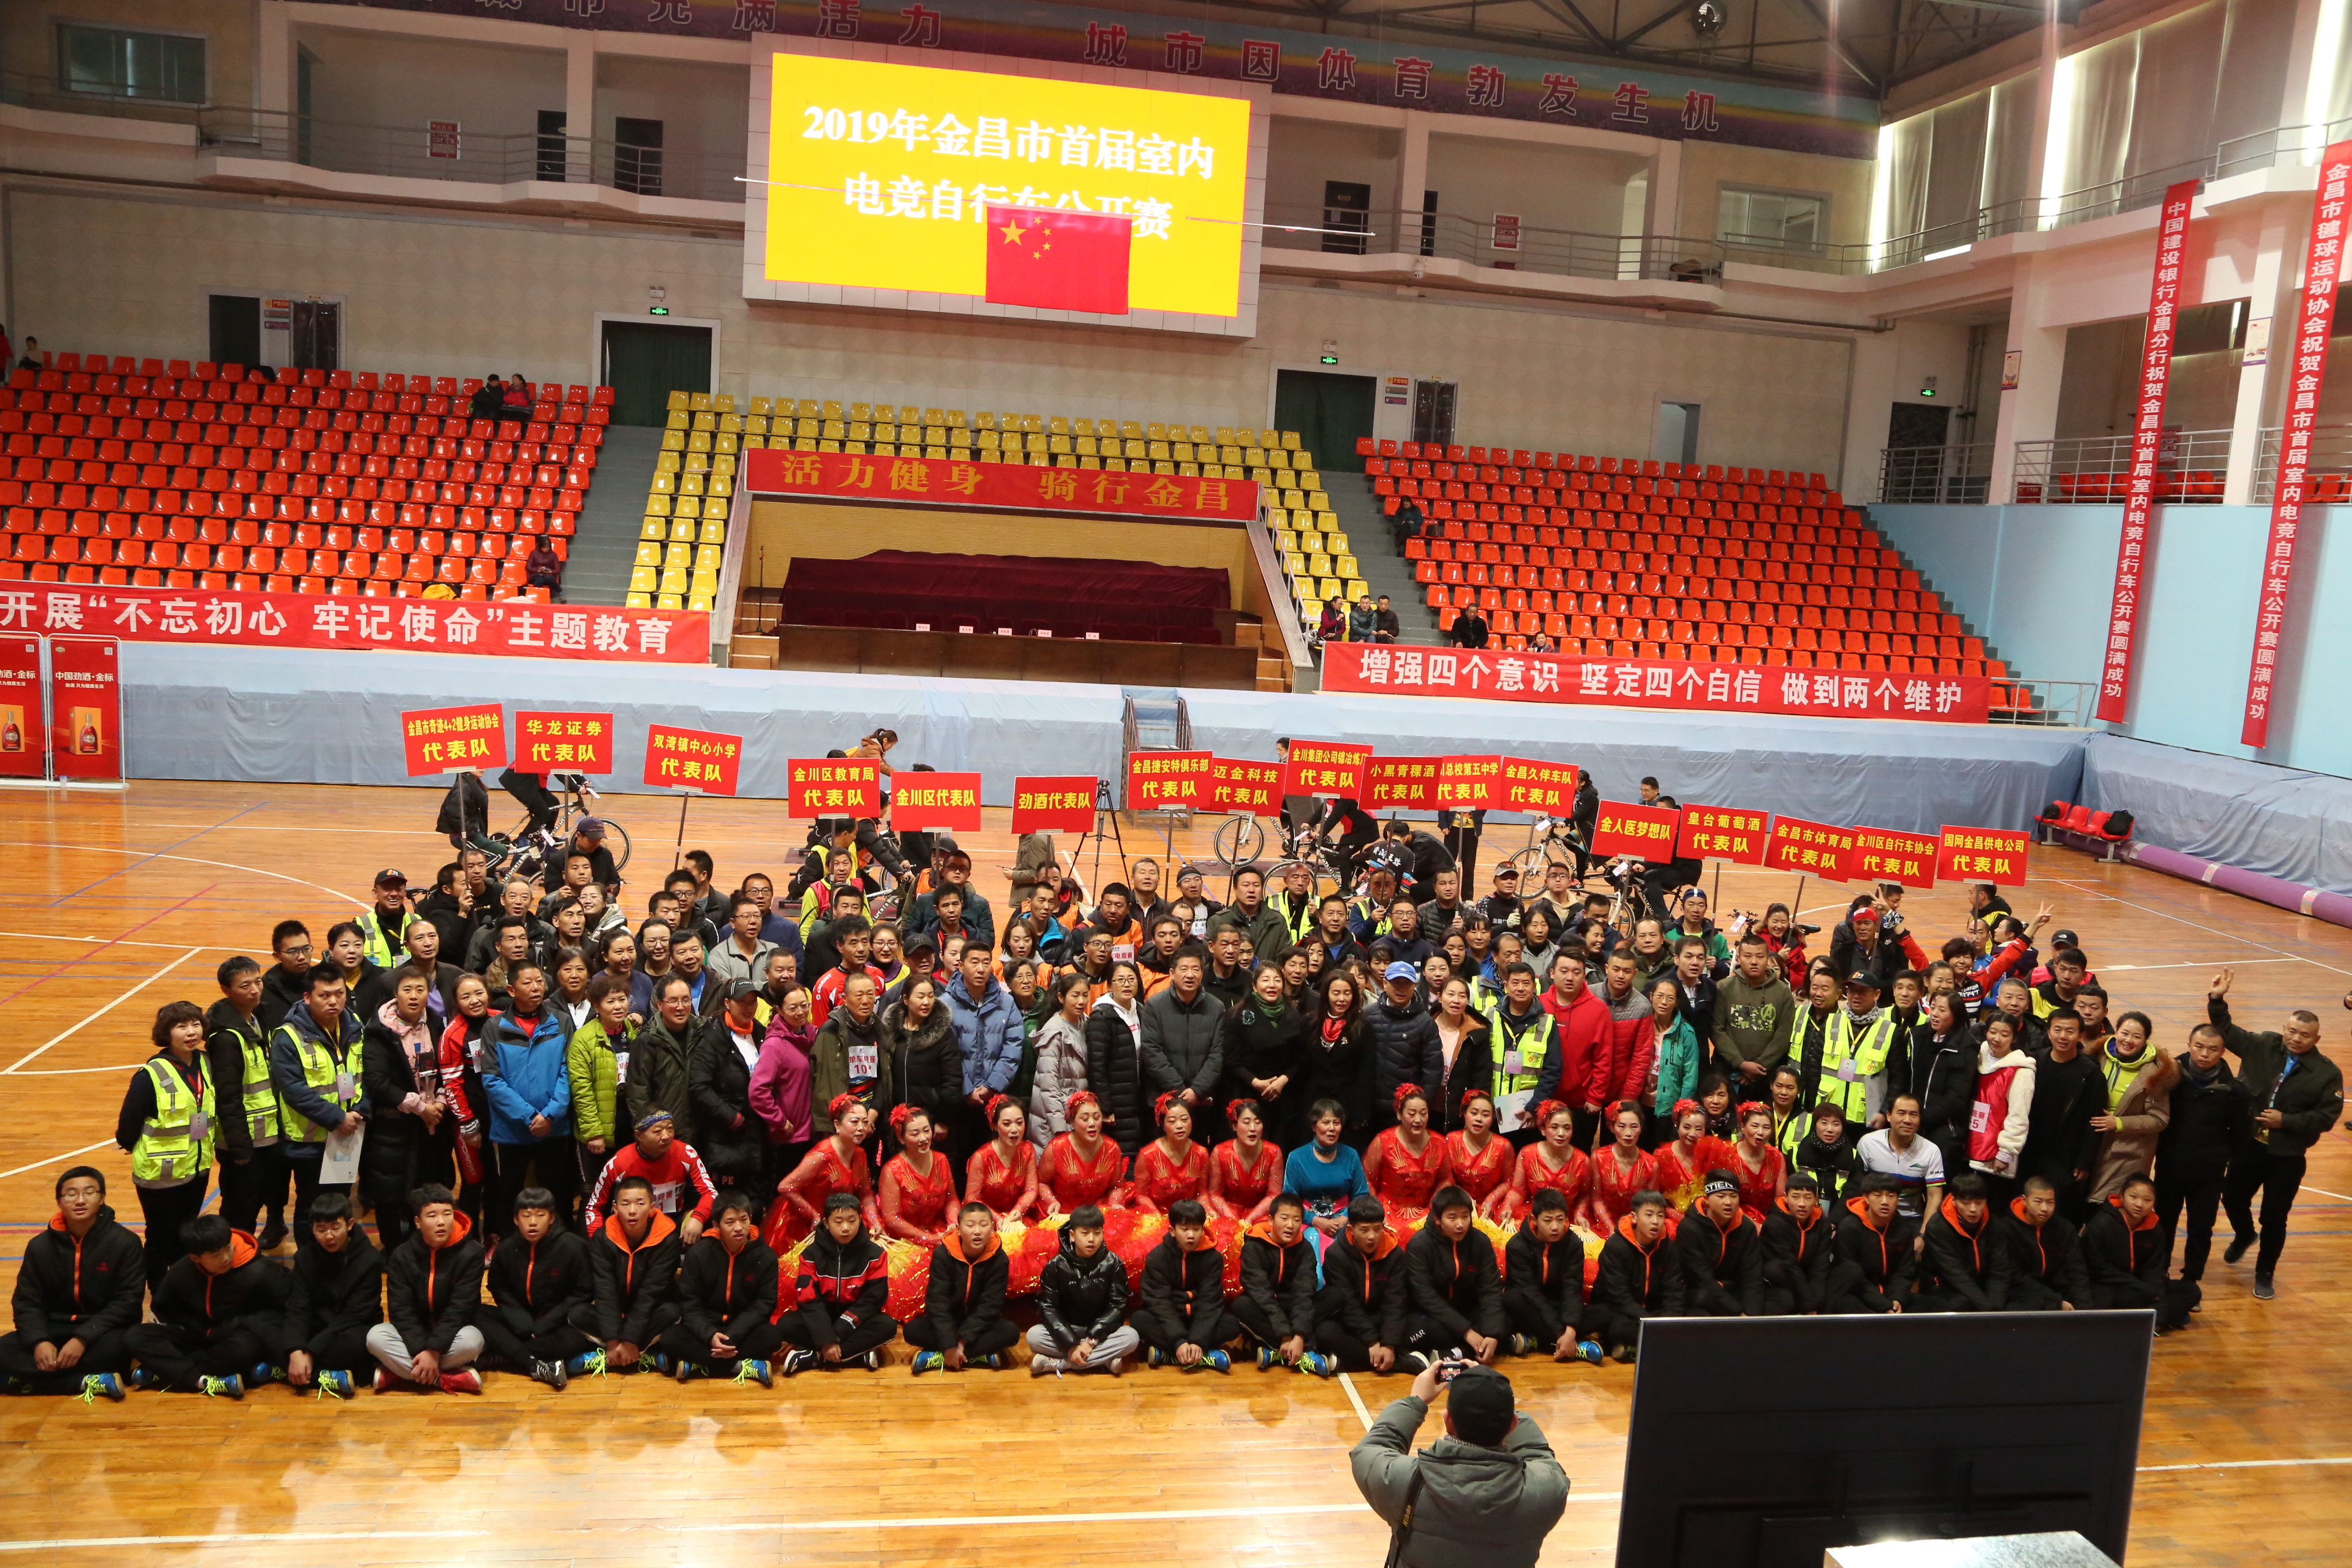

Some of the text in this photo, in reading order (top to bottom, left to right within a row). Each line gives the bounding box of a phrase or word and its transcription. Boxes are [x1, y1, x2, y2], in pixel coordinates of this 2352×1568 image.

[1084, 21, 1718, 132] 城市因体育勃发生机
[802, 107, 1215, 180] 2019年金昌市首届室内
[2105, 202, 2186, 698] 中国建设银行金昌分行祝贺金昌市首届室内电竞自行车公开赛圆满成功
[782, 454, 1229, 511] 活力健身 骑行金昌
[0, 590, 673, 655] 开展“不忘初心 牢记使命”主题教育
[55, 671, 115, 683] 中国劲酒·金标
[1358, 649, 1963, 715] 增强四个意识 坚定四个自信 做到两个维护
[408, 711, 499, 737] 金昌市奇迹4+2健身运动协会
[526, 719, 602, 736] 华龙证券
[423, 738, 490, 763] 代表队
[531, 743, 596, 762] 代表队
[653, 734, 736, 759] 双湾镇中心小学
[1292, 747, 1368, 766] 金川集团公司镍冶炼厂
[660, 757, 722, 783] 代表队
[794, 767, 874, 782] 金川区教育局
[1133, 758, 1209, 774] 金昌捷安特俱乐部
[1213, 764, 1278, 783] 迈金科技
[1370, 764, 1435, 777] 小黑青稞酒
[1505, 764, 1572, 785] 金昌久伴车队
[1300, 769, 1355, 788] 代表队
[803, 789, 865, 807] 代表队
[896, 788, 975, 807] 金川区代表队
[1142, 780, 1197, 799] 代表队
[1215, 786, 1268, 805] 代表队
[1373, 783, 1425, 801] 代表队
[1438, 783, 1488, 800] 代表队
[1510, 786, 1561, 807] 代表队
[1018, 792, 1091, 810] 劲酒代表队
[1600, 816, 1670, 842] 金人医梦想队
[1687, 812, 1760, 832] 皇台葡萄酒
[1693, 833, 1749, 854] 代表队
[1777, 824, 1852, 851] 金昌市体育局
[1856, 834, 1935, 857] 金川区自行车协会
[1944, 835, 2024, 853] 国网金昌供电公司
[1781, 845, 1838, 870] 代表队
[1863, 854, 1920, 878] 代表队
[1953, 855, 2011, 875] 代表队
[818, 973, 832, 994] GIANT
[854, 1065, 872, 1074] 10
[1402, 1504, 1412, 1528] Nikon
